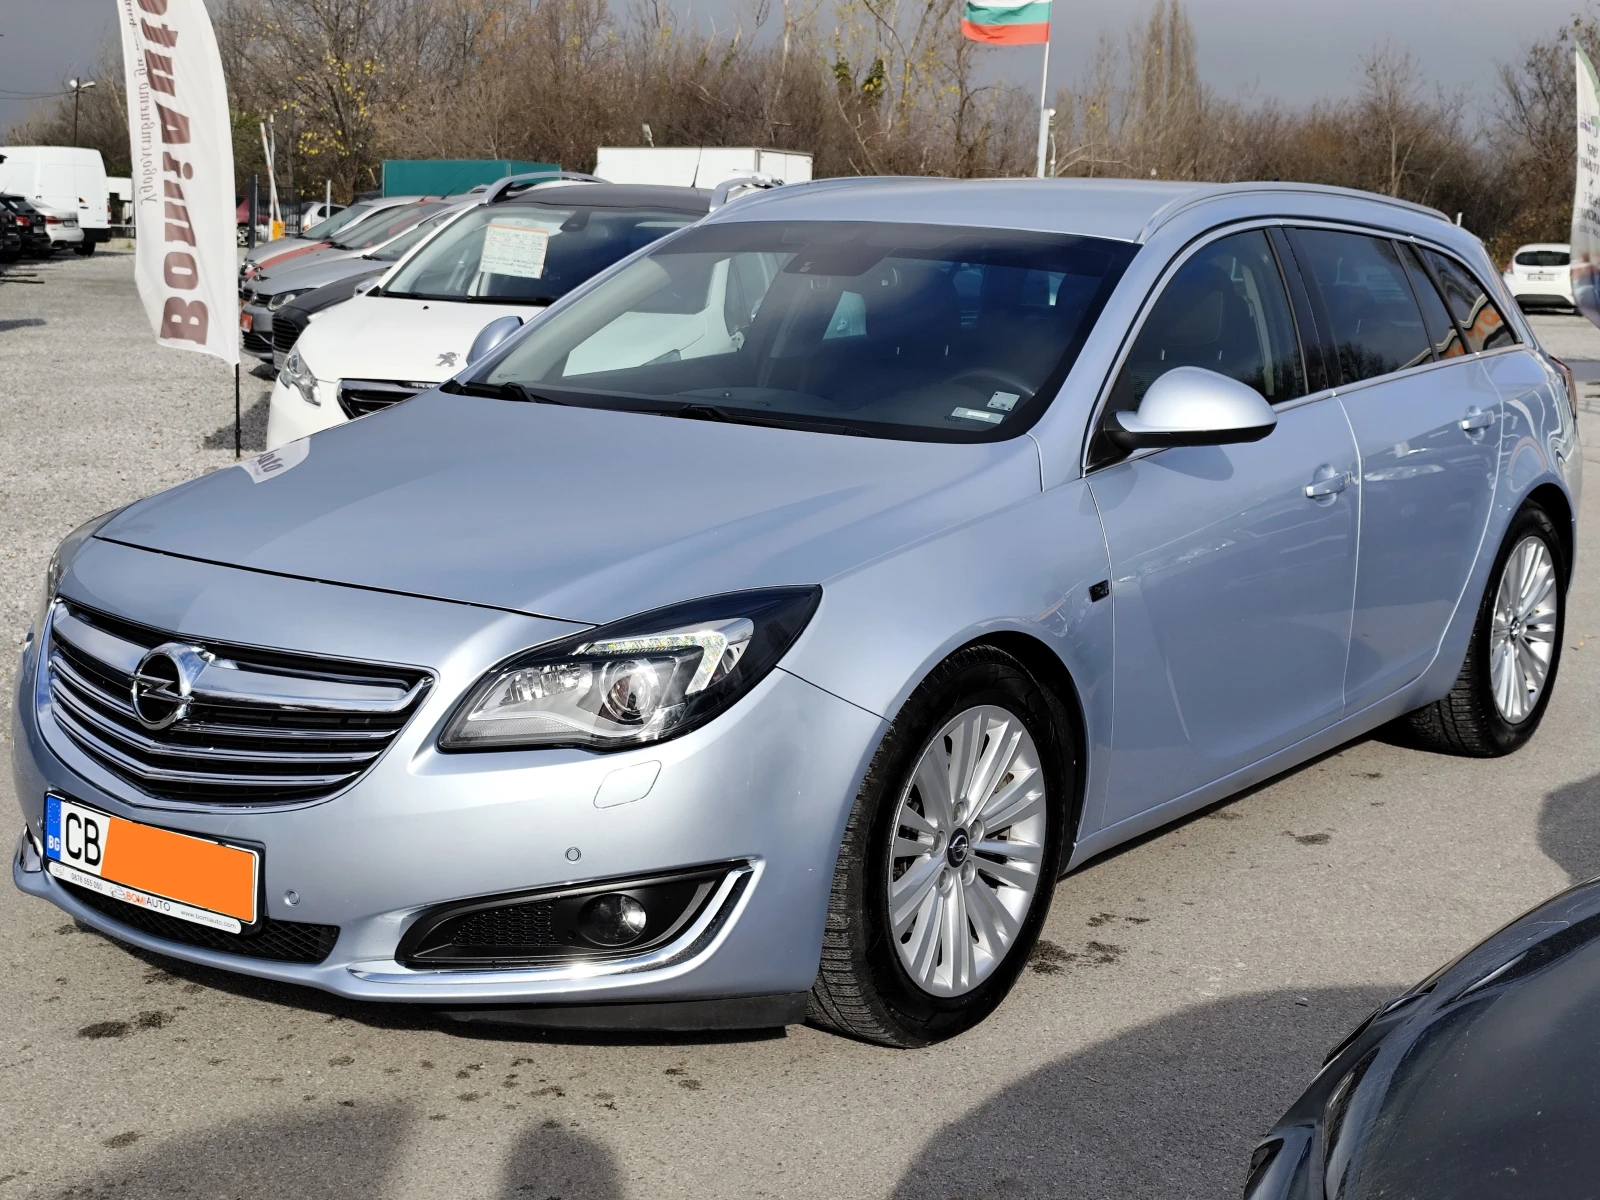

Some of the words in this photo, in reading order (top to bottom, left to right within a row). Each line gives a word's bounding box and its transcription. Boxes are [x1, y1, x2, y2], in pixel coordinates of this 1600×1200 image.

[48, 834, 61, 852] BG
[65, 812, 101, 867] CB
[83, 879, 93, 888] 555
[181, 910, 237, 930] www.bomiauto.com
